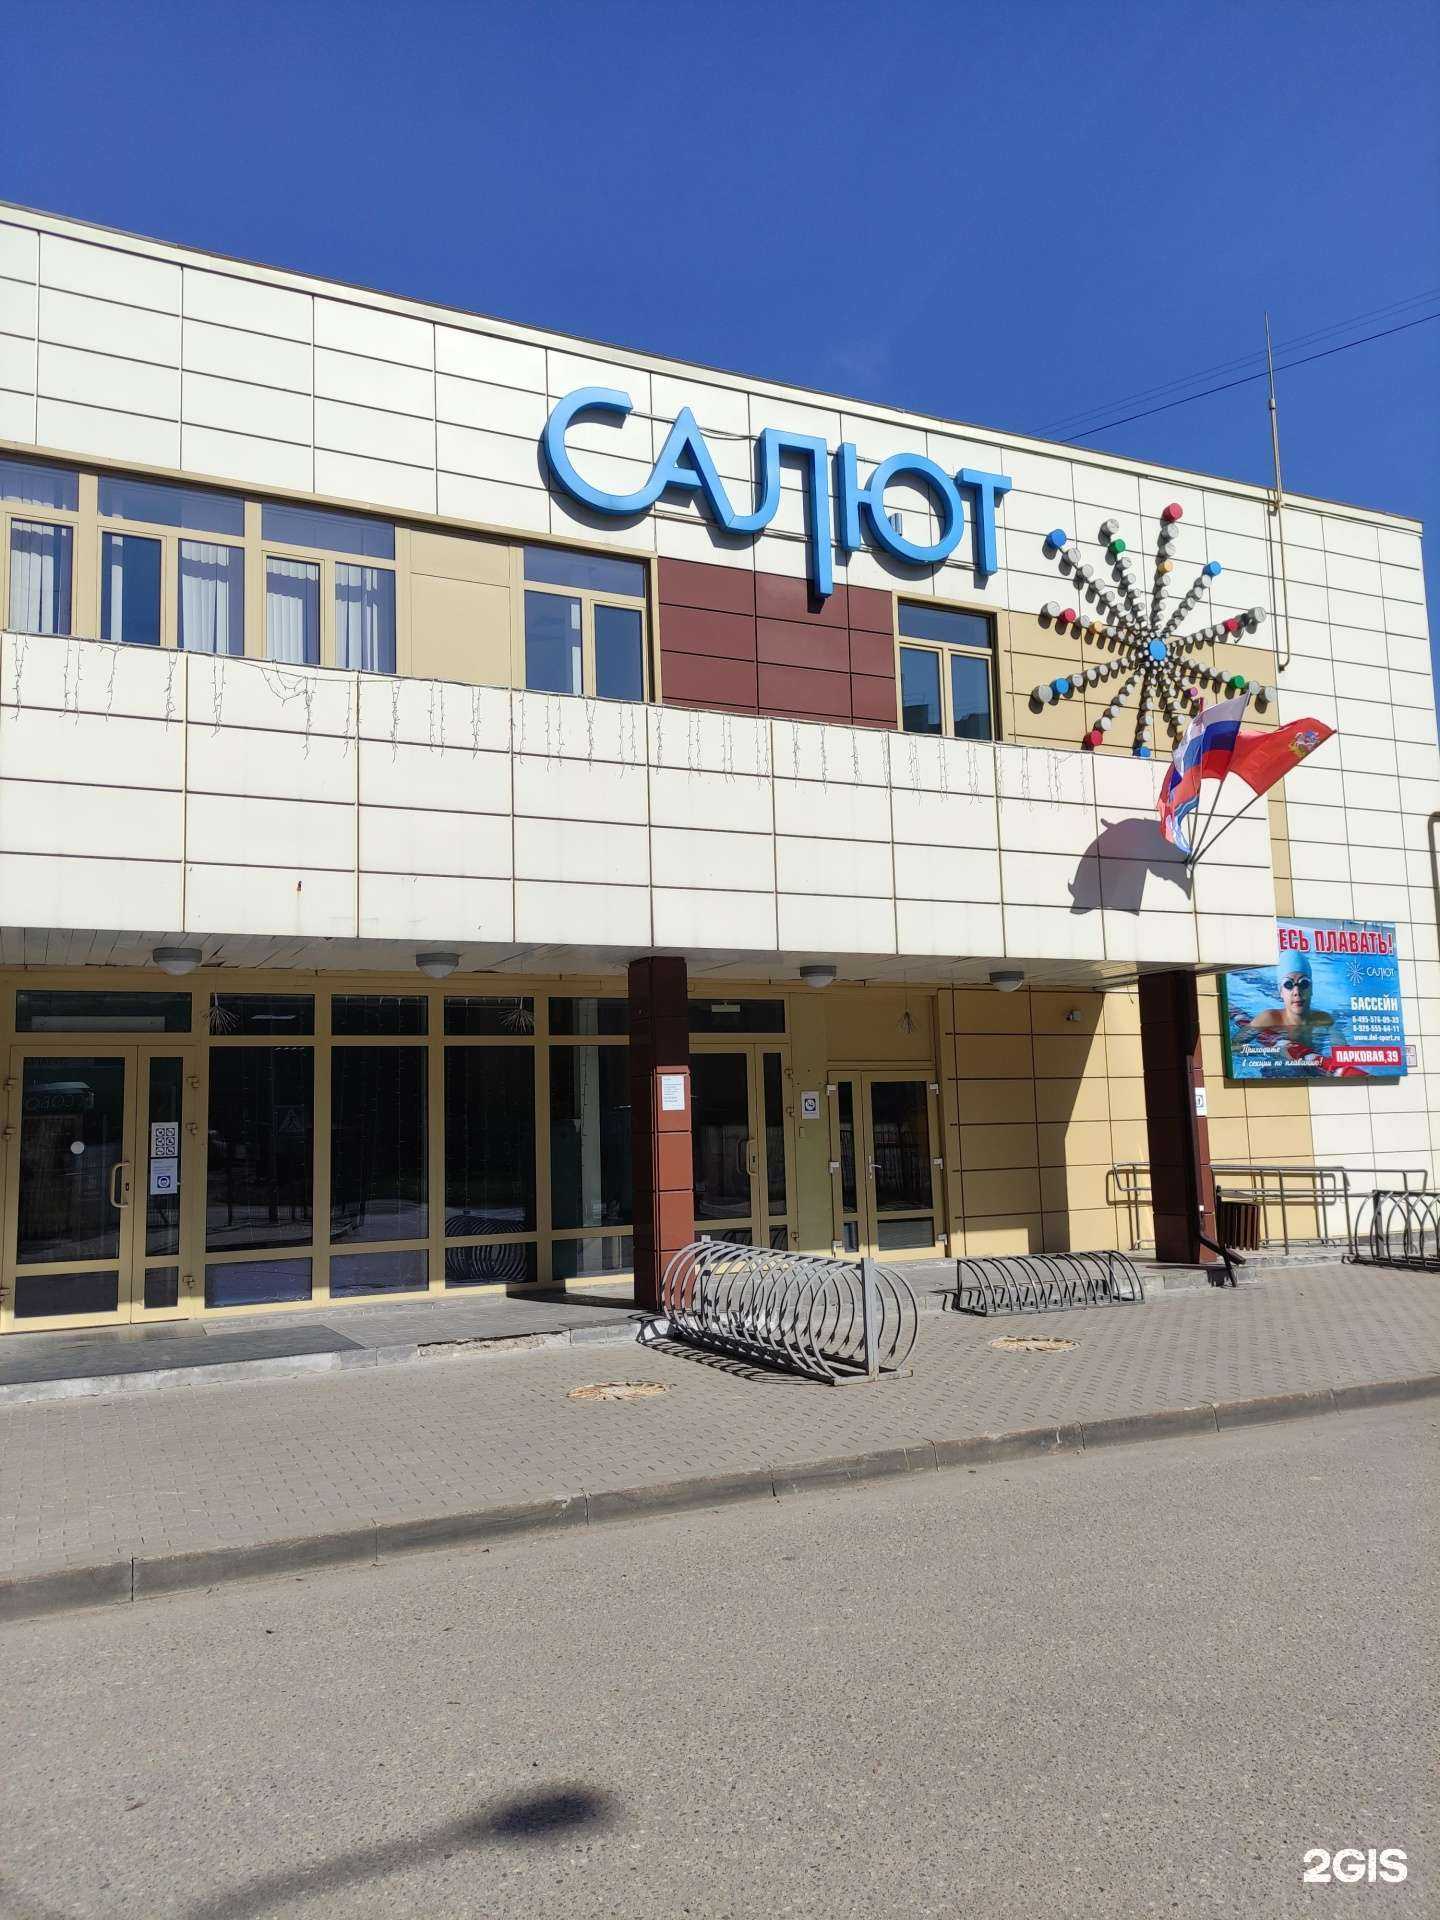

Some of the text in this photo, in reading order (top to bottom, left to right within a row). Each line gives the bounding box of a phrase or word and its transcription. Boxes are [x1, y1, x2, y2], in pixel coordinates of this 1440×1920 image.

[543, 386, 1012, 597] САЛЮТ
[1314, 930, 1393, 954] ПЛАВАТЬ!
[1366, 967, 1395, 980] САЛЮТ
[1351, 994, 1398, 1011] БАССЕЙН
[1240, 1044, 1280, 1055] Приходите
